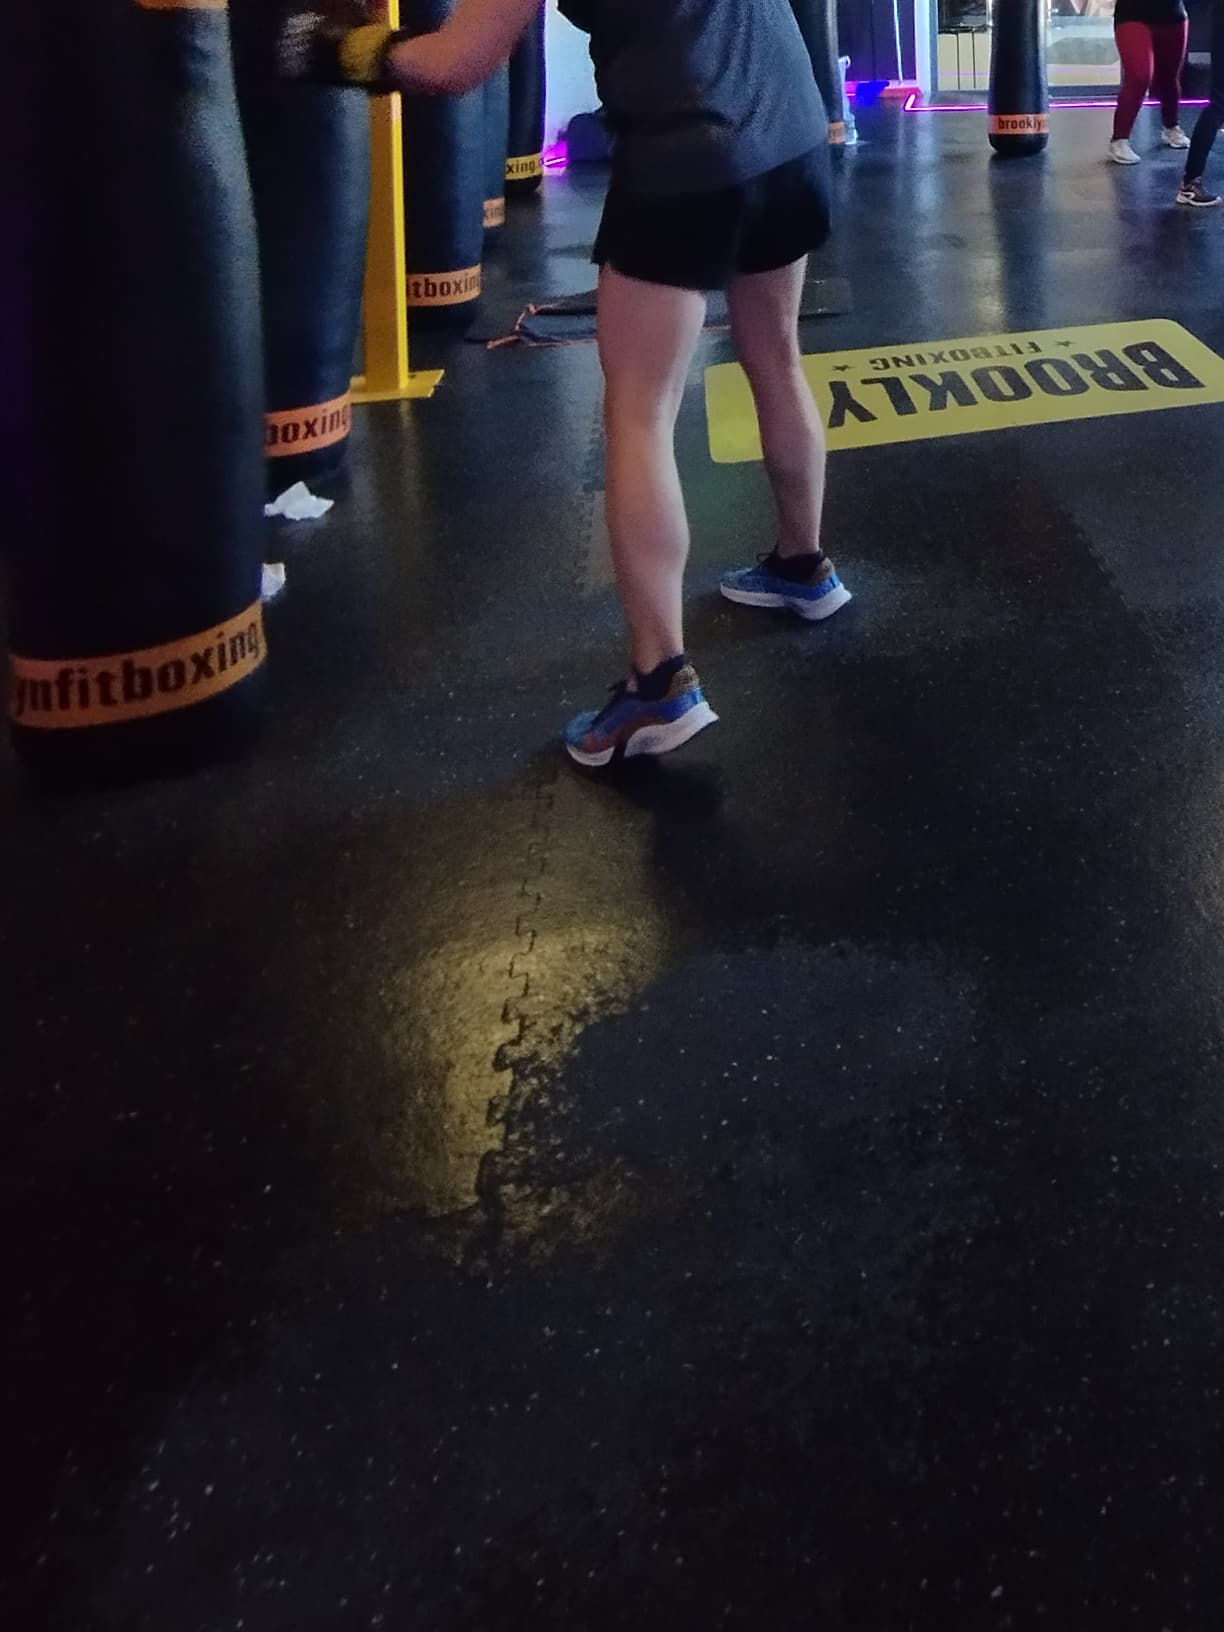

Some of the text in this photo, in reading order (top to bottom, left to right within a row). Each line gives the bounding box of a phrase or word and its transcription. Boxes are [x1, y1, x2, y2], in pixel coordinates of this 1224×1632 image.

[998, 117, 1042, 131] brookly
[870, 341, 1043, 373] FITBOXING
[828, 341, 1206, 429] BROOKLY
